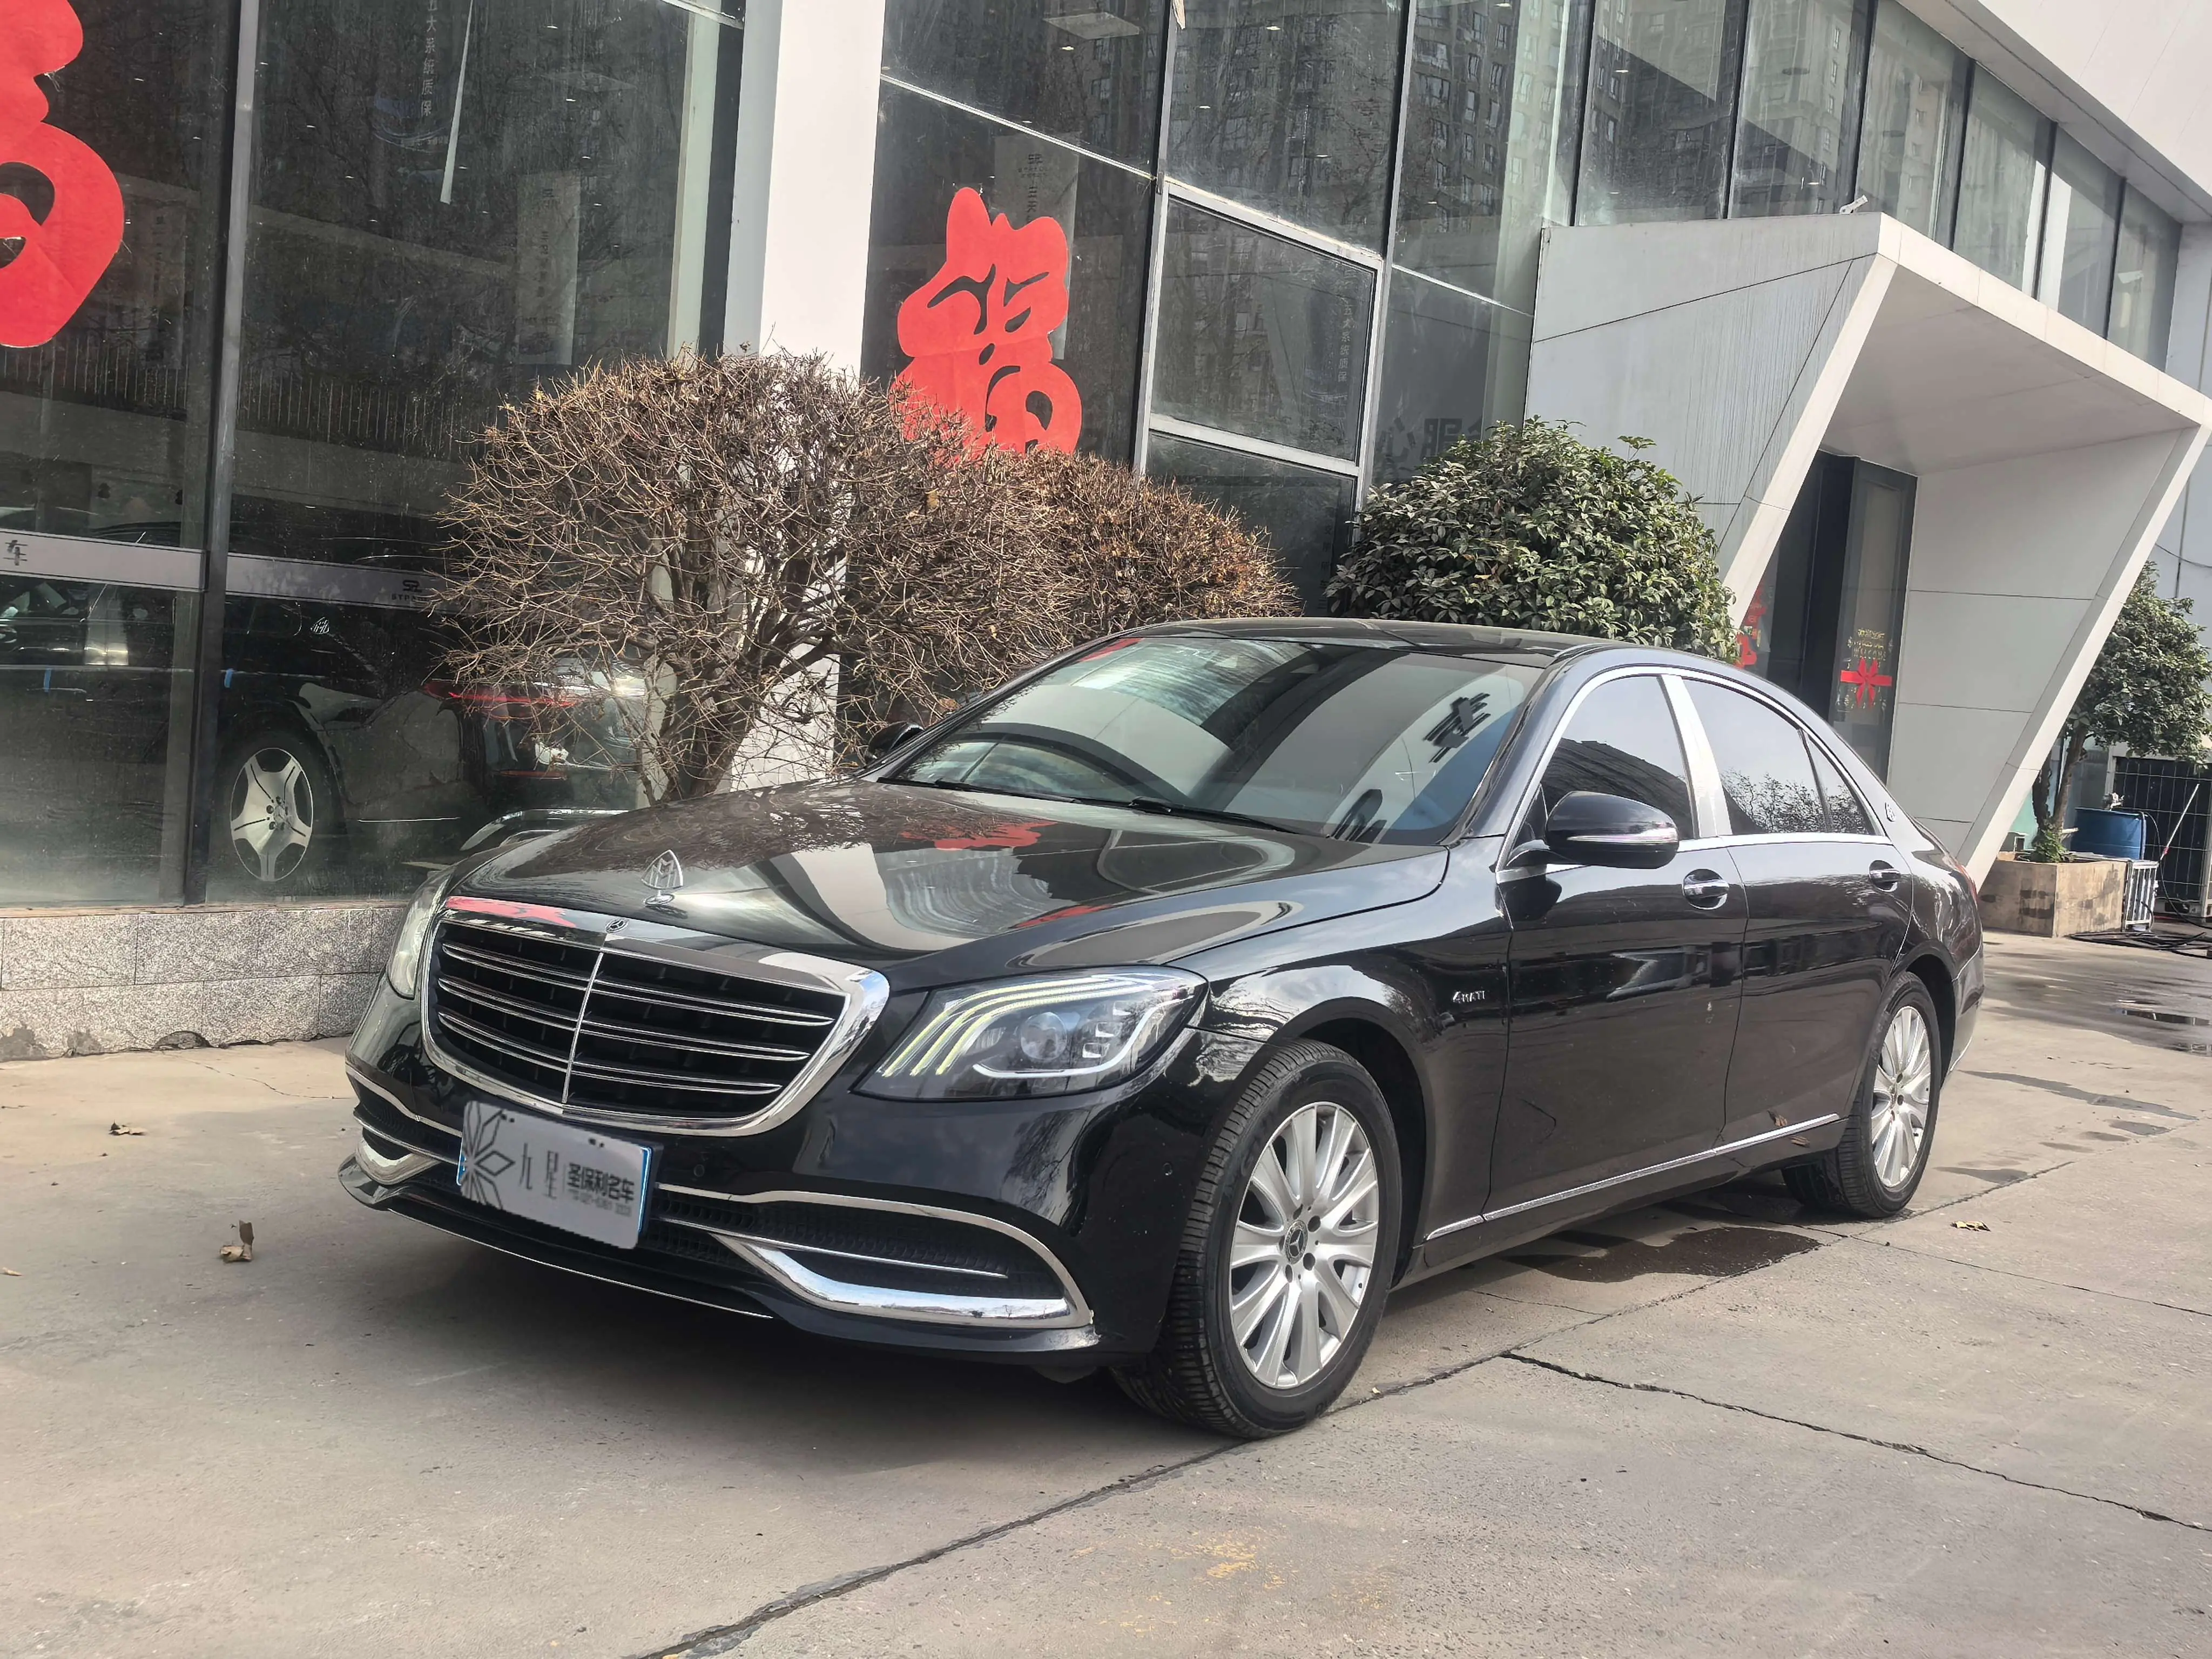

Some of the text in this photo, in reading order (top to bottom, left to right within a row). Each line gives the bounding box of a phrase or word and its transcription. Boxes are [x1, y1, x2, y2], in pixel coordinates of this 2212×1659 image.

[1375, 416, 1483, 462] 心服
[566, 1162, 635, 1204] 圣保利名车
